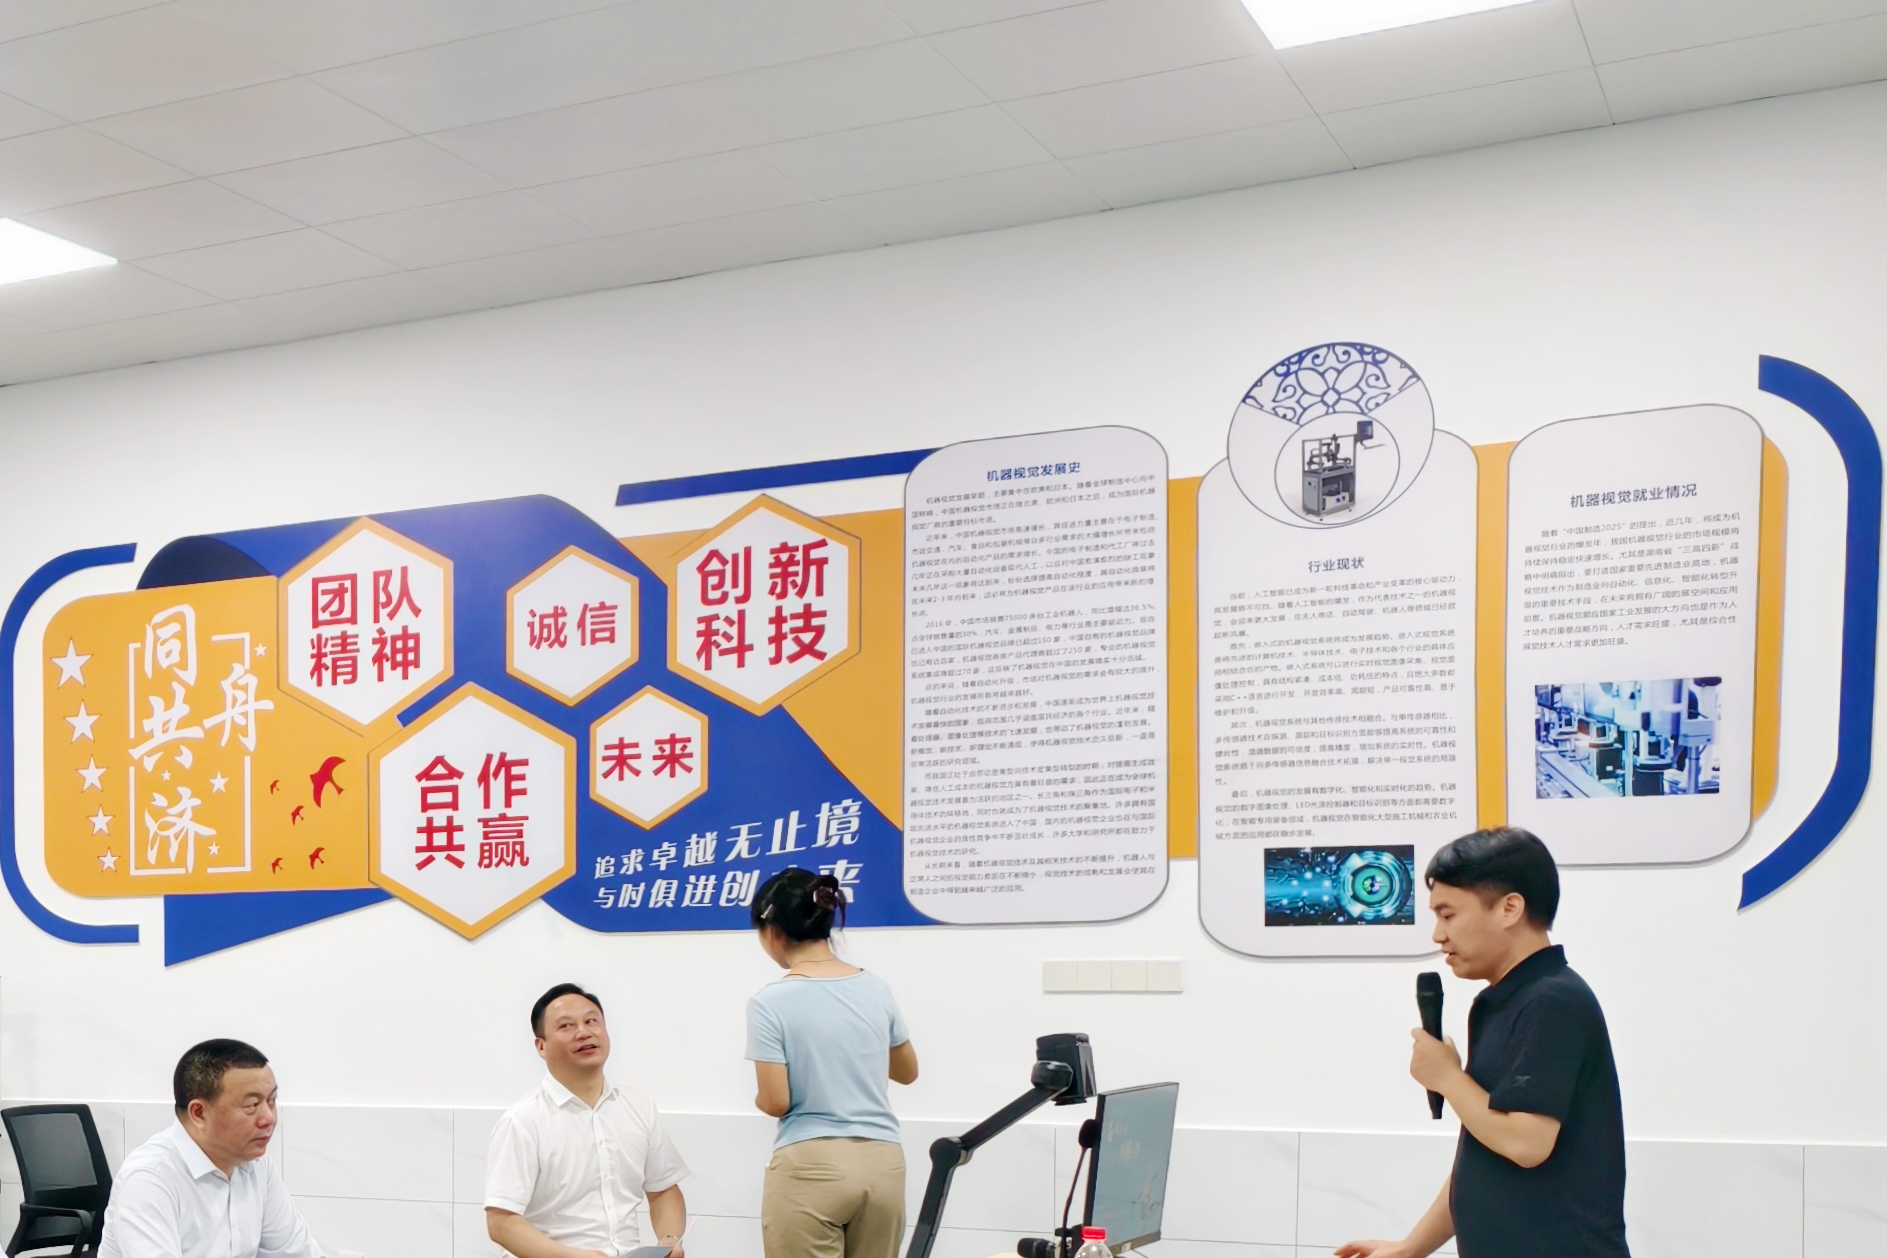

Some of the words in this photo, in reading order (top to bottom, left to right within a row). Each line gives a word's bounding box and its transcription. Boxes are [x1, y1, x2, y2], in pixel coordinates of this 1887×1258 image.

[986, 460, 1080, 482] 机器视觉发展史
[1570, 482, 1697, 508] 机器视觉就业情况
[696, 538, 829, 609] 创新
[1307, 556, 1364, 573] 行业现状
[311, 566, 422, 628] 团队
[527, 601, 617, 650] 诚信
[310, 623, 421, 687] 精神
[695, 603, 827, 670] 科技
[415, 752, 529, 812] 合作
[601, 733, 693, 782] 未来
[415, 810, 530, 870] 共赢
[594, 798, 863, 880] 追求卓越无止境
[593, 858, 864, 909] 与时俱进创来
